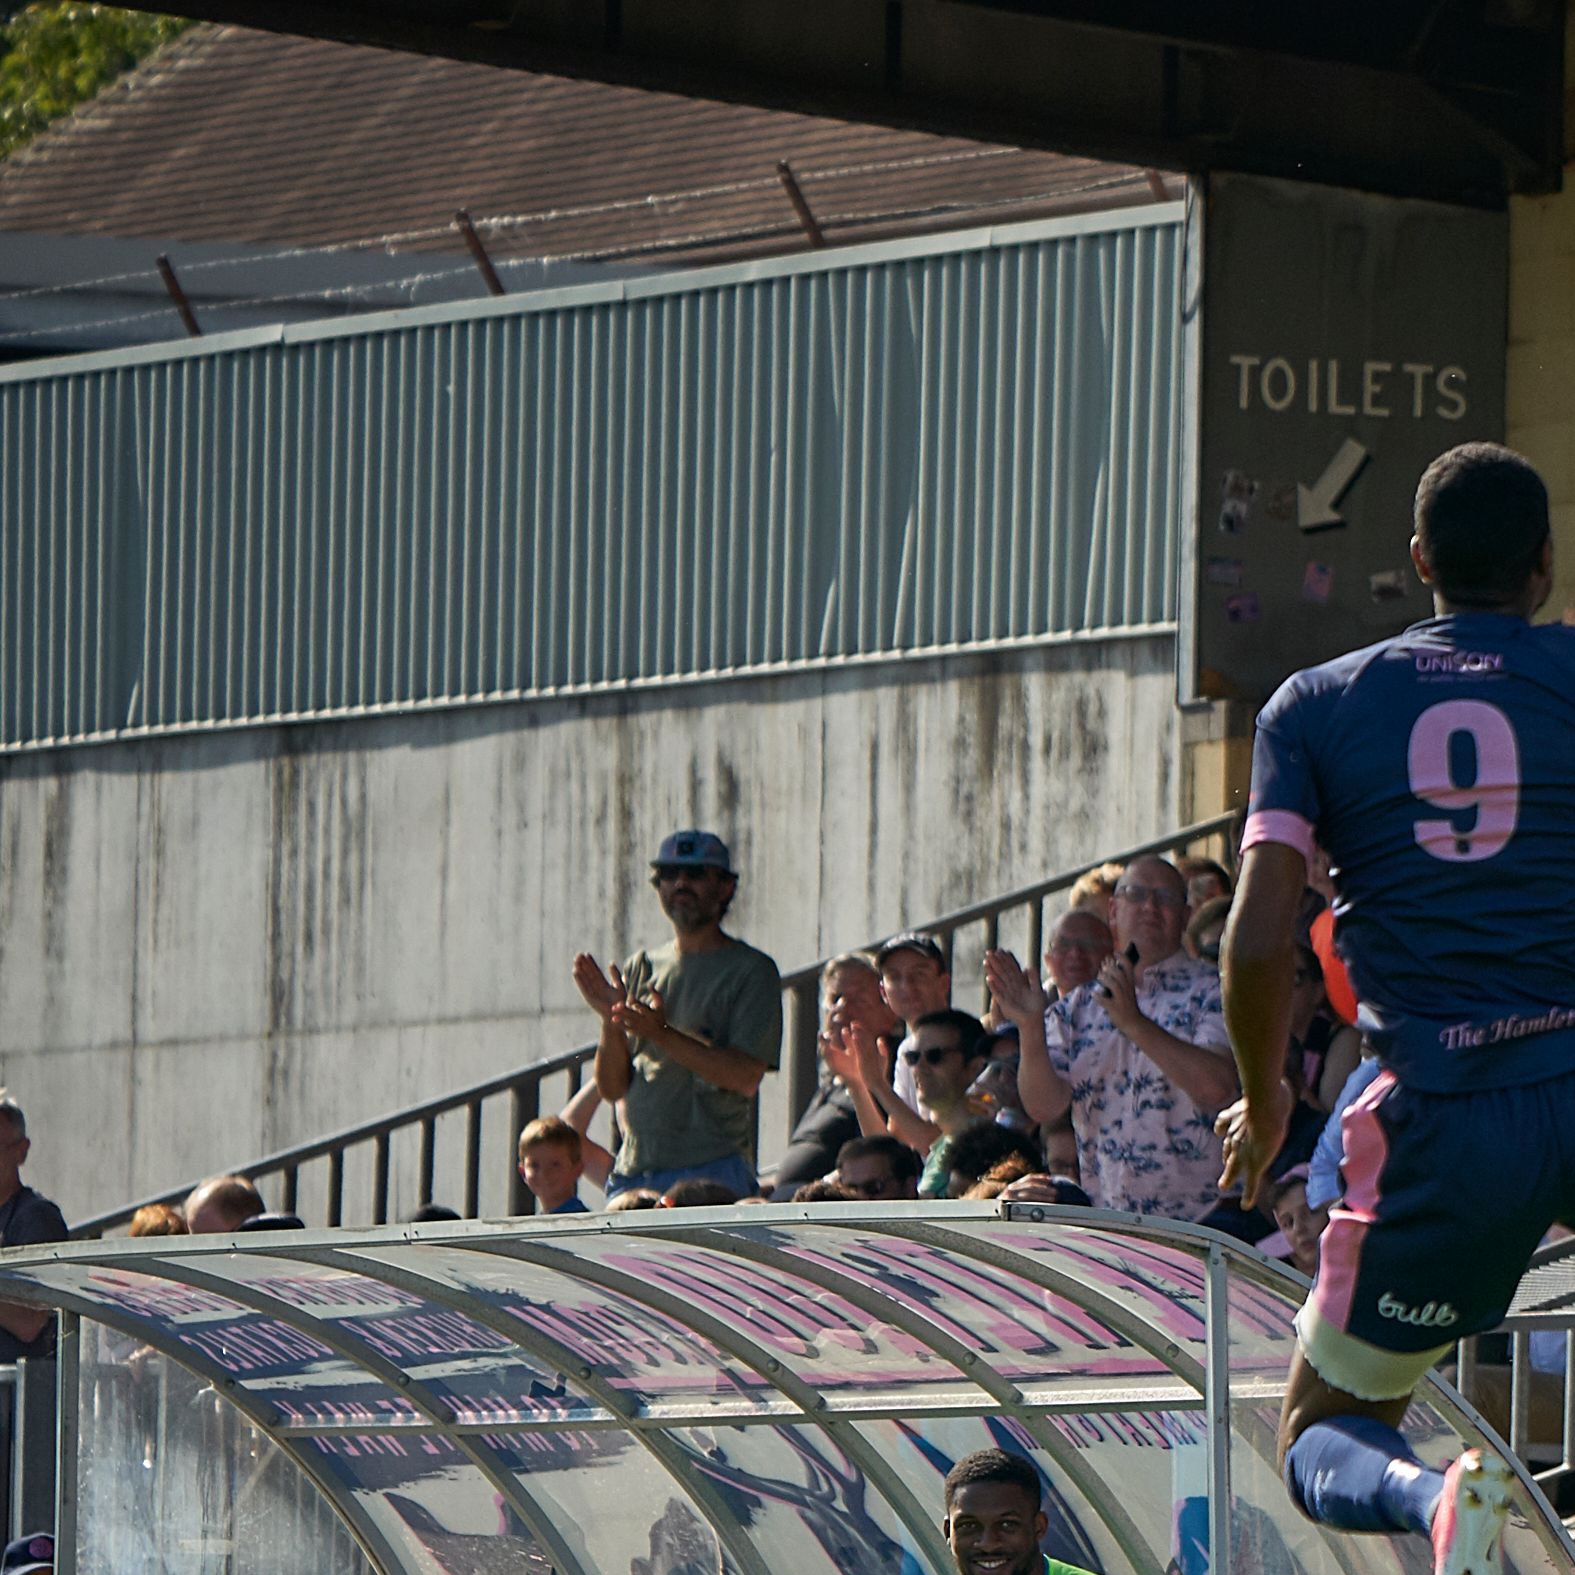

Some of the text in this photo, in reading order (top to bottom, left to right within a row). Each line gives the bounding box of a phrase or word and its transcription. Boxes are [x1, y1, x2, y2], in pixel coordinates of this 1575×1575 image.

[1229, 355, 1468, 420] TOILETS
[1416, 652, 1504, 673] UNISON
[1407, 699, 1521, 864] 9
[1439, 1022, 1485, 1050] The
[1377, 1291, 1458, 1327] bulb
